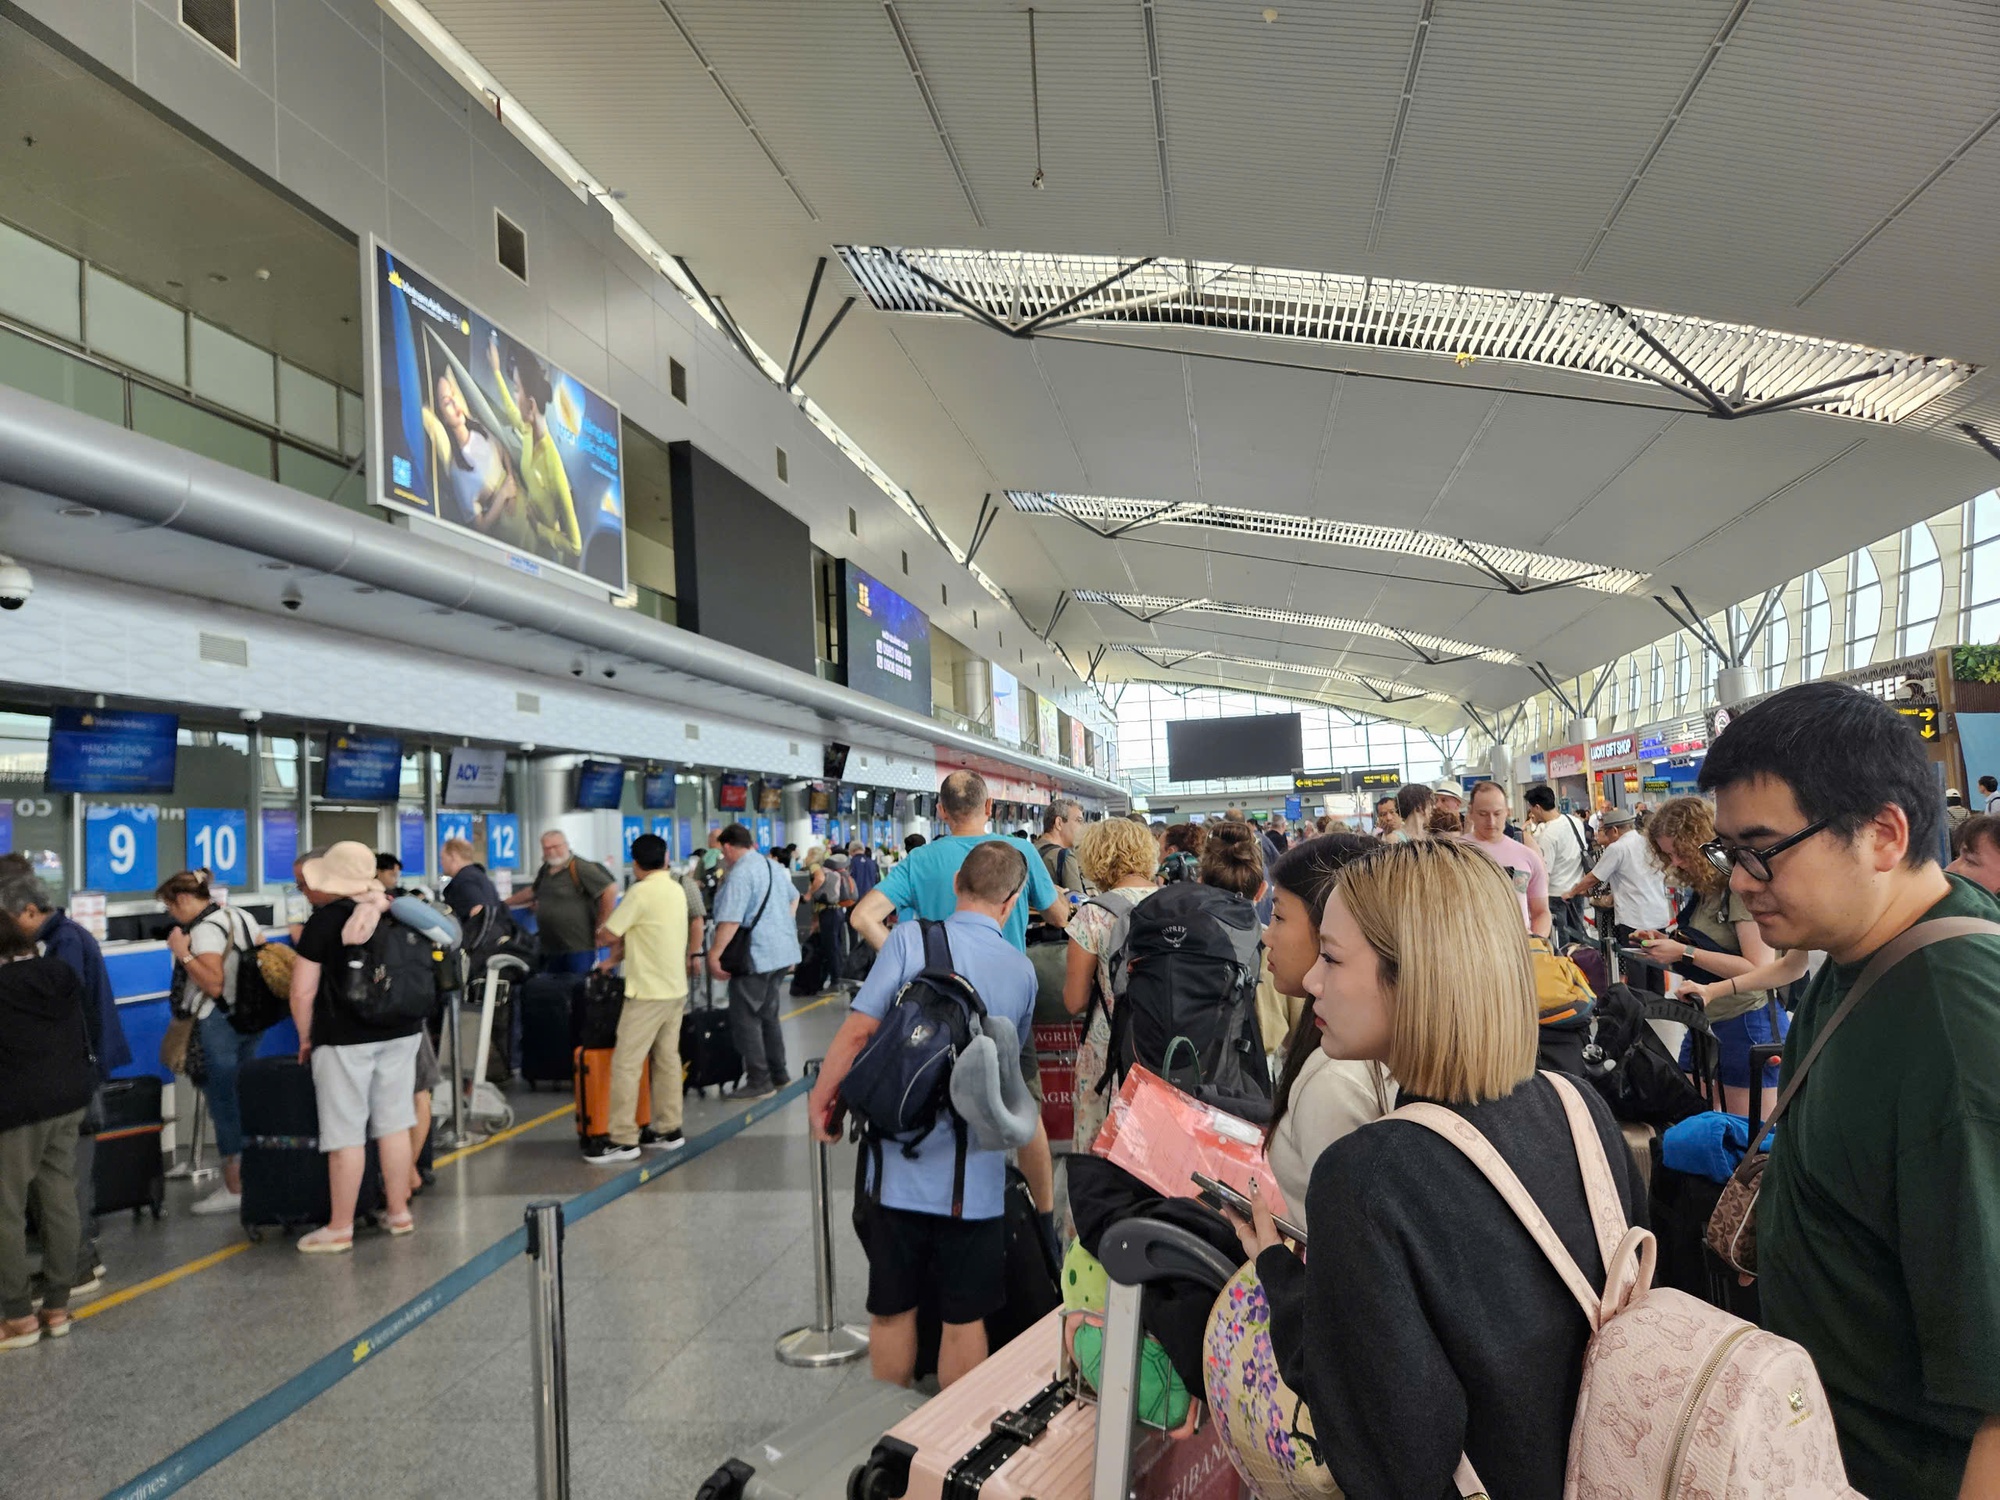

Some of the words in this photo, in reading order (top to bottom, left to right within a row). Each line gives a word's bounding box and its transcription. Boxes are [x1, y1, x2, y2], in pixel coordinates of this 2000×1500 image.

[1852, 675, 1907, 701] FFEE
[1591, 744, 1605, 760] LUCKY
[1605, 741, 1616, 757] GIFT
[1616, 738, 1631, 755] SHOP
[456, 763, 480, 781] ACV
[109, 824, 136, 875] 9
[195, 824, 237, 871] 10
[492, 825, 515, 858] 12
[1161, 925, 1188, 935] OSPREY
[1034, 1031, 1081, 1043] AGRIB
